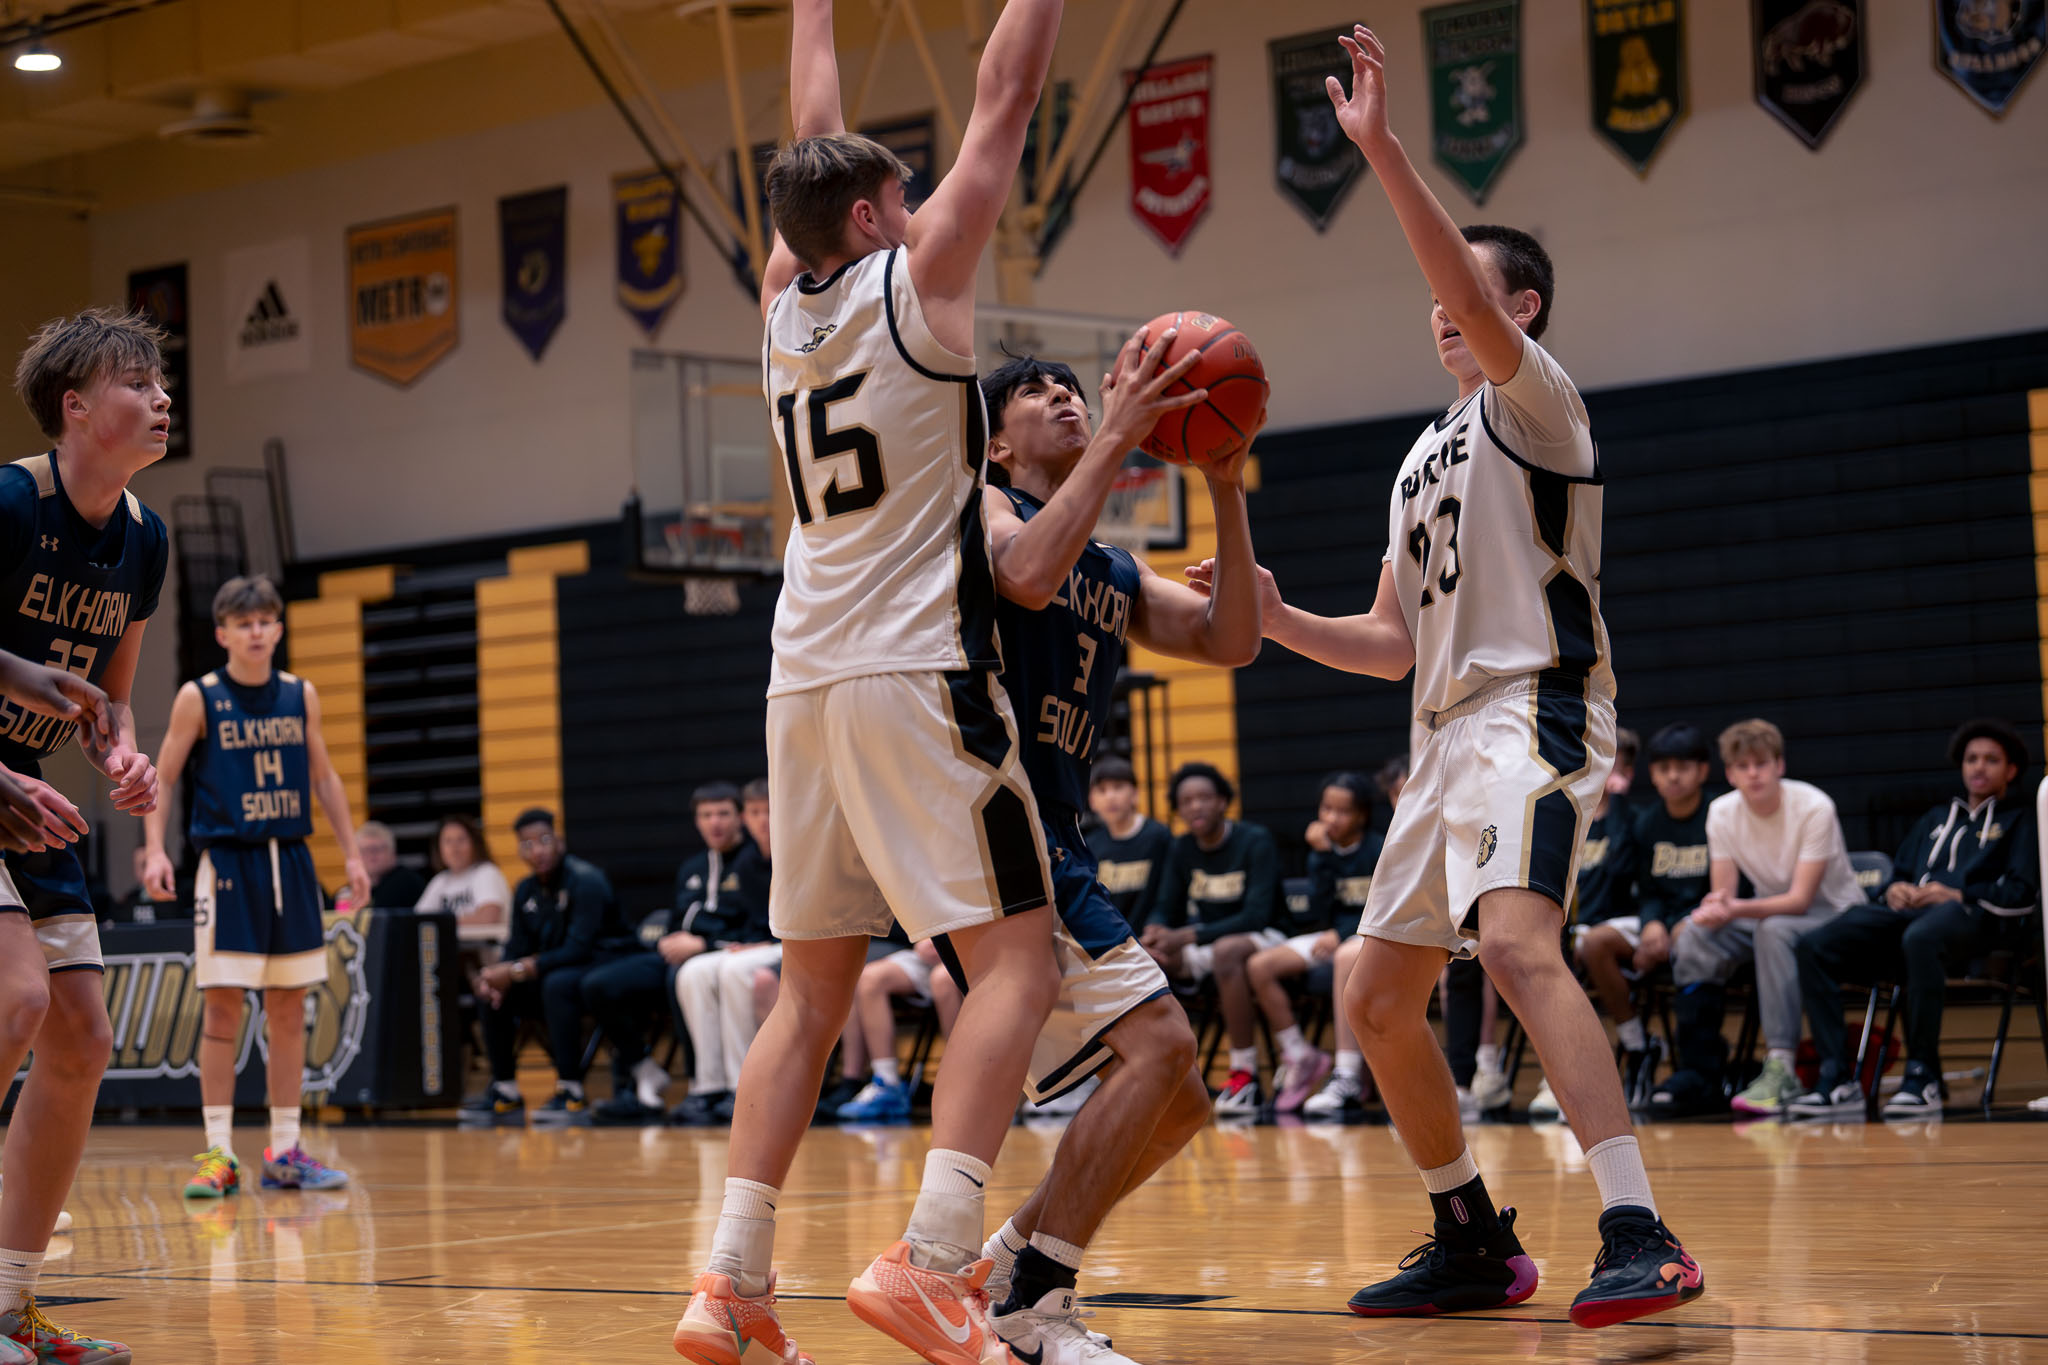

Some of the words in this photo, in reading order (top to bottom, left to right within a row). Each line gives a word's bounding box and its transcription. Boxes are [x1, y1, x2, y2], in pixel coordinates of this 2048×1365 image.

[777, 367, 888, 527] 15
[1407, 495, 1463, 609] 23
[19, 573, 131, 637] ELKHORN
[1073, 632, 1098, 695] 3
[219, 716, 304, 750] ELKHORN
[253, 750, 284, 788] 14
[242, 790, 301, 822] SOUTH
